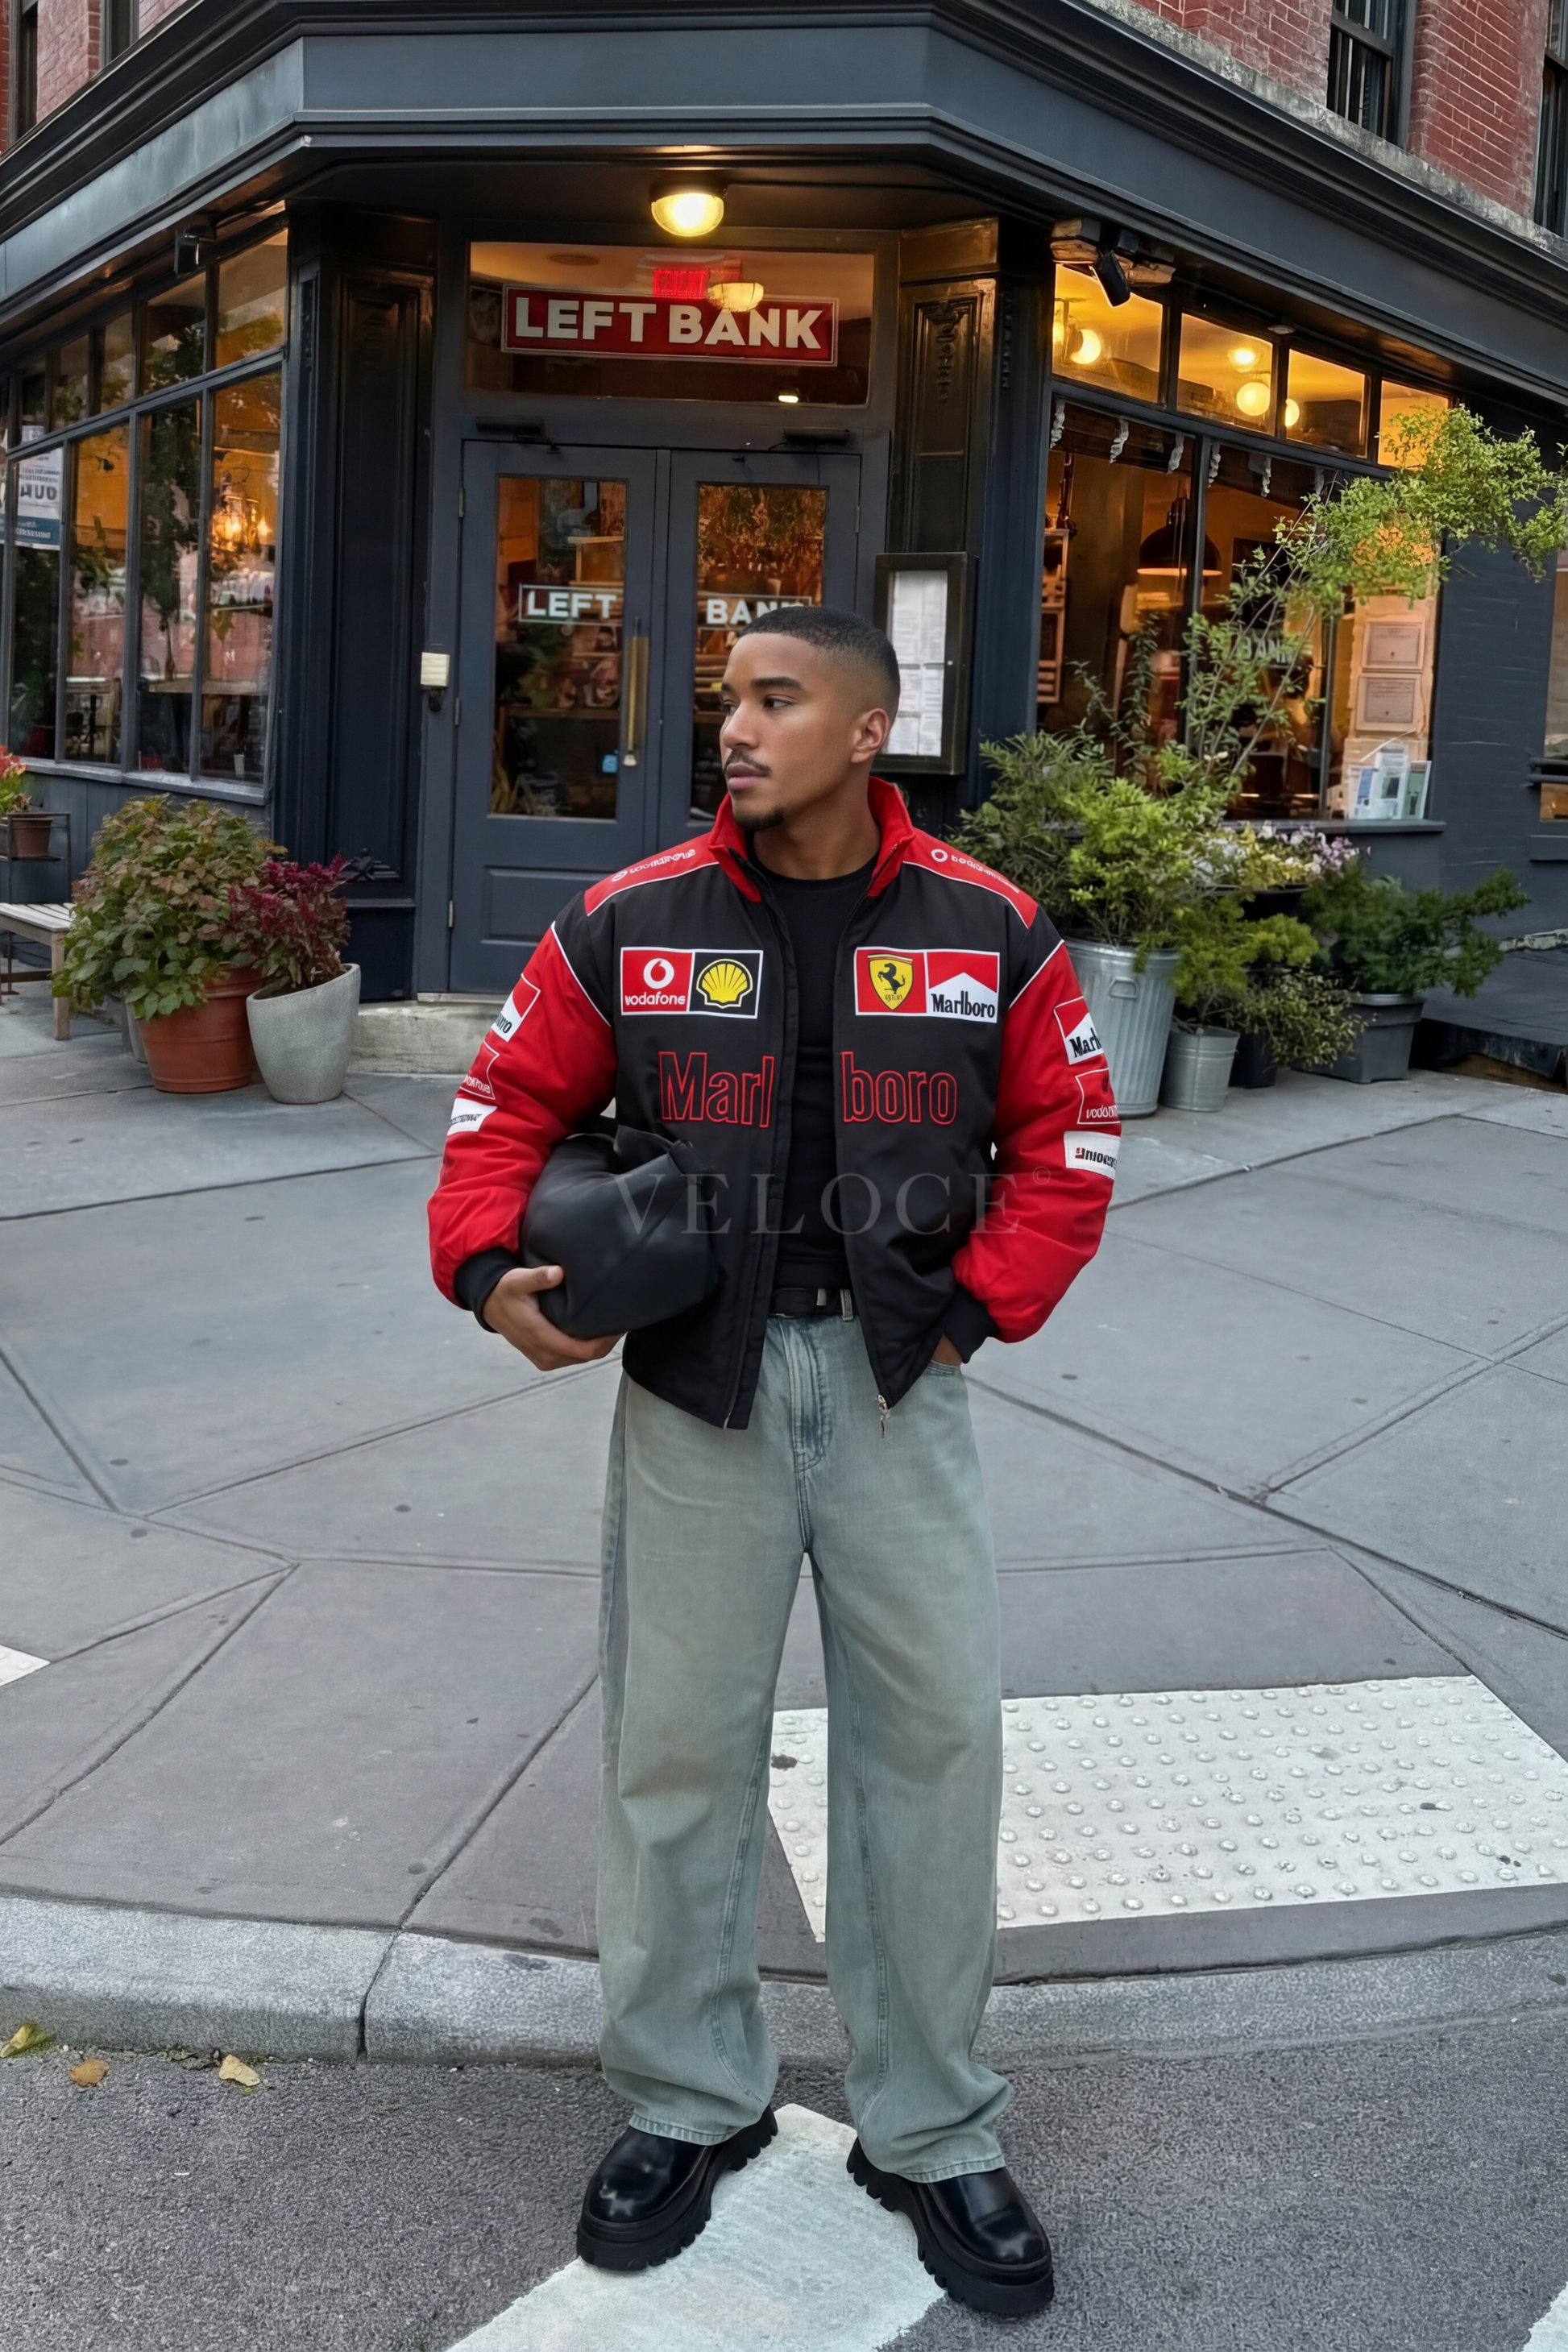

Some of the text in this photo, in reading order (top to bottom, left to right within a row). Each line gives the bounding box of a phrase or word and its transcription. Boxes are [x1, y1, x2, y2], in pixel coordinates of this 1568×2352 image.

[515, 297, 823, 350] LEFT BANK
[527, 590, 805, 625] LEFT BAN
[624, 991, 686, 1006] vodafone
[931, 990, 996, 1018] Marlboro
[658, 1051, 958, 1128] Marl boro
